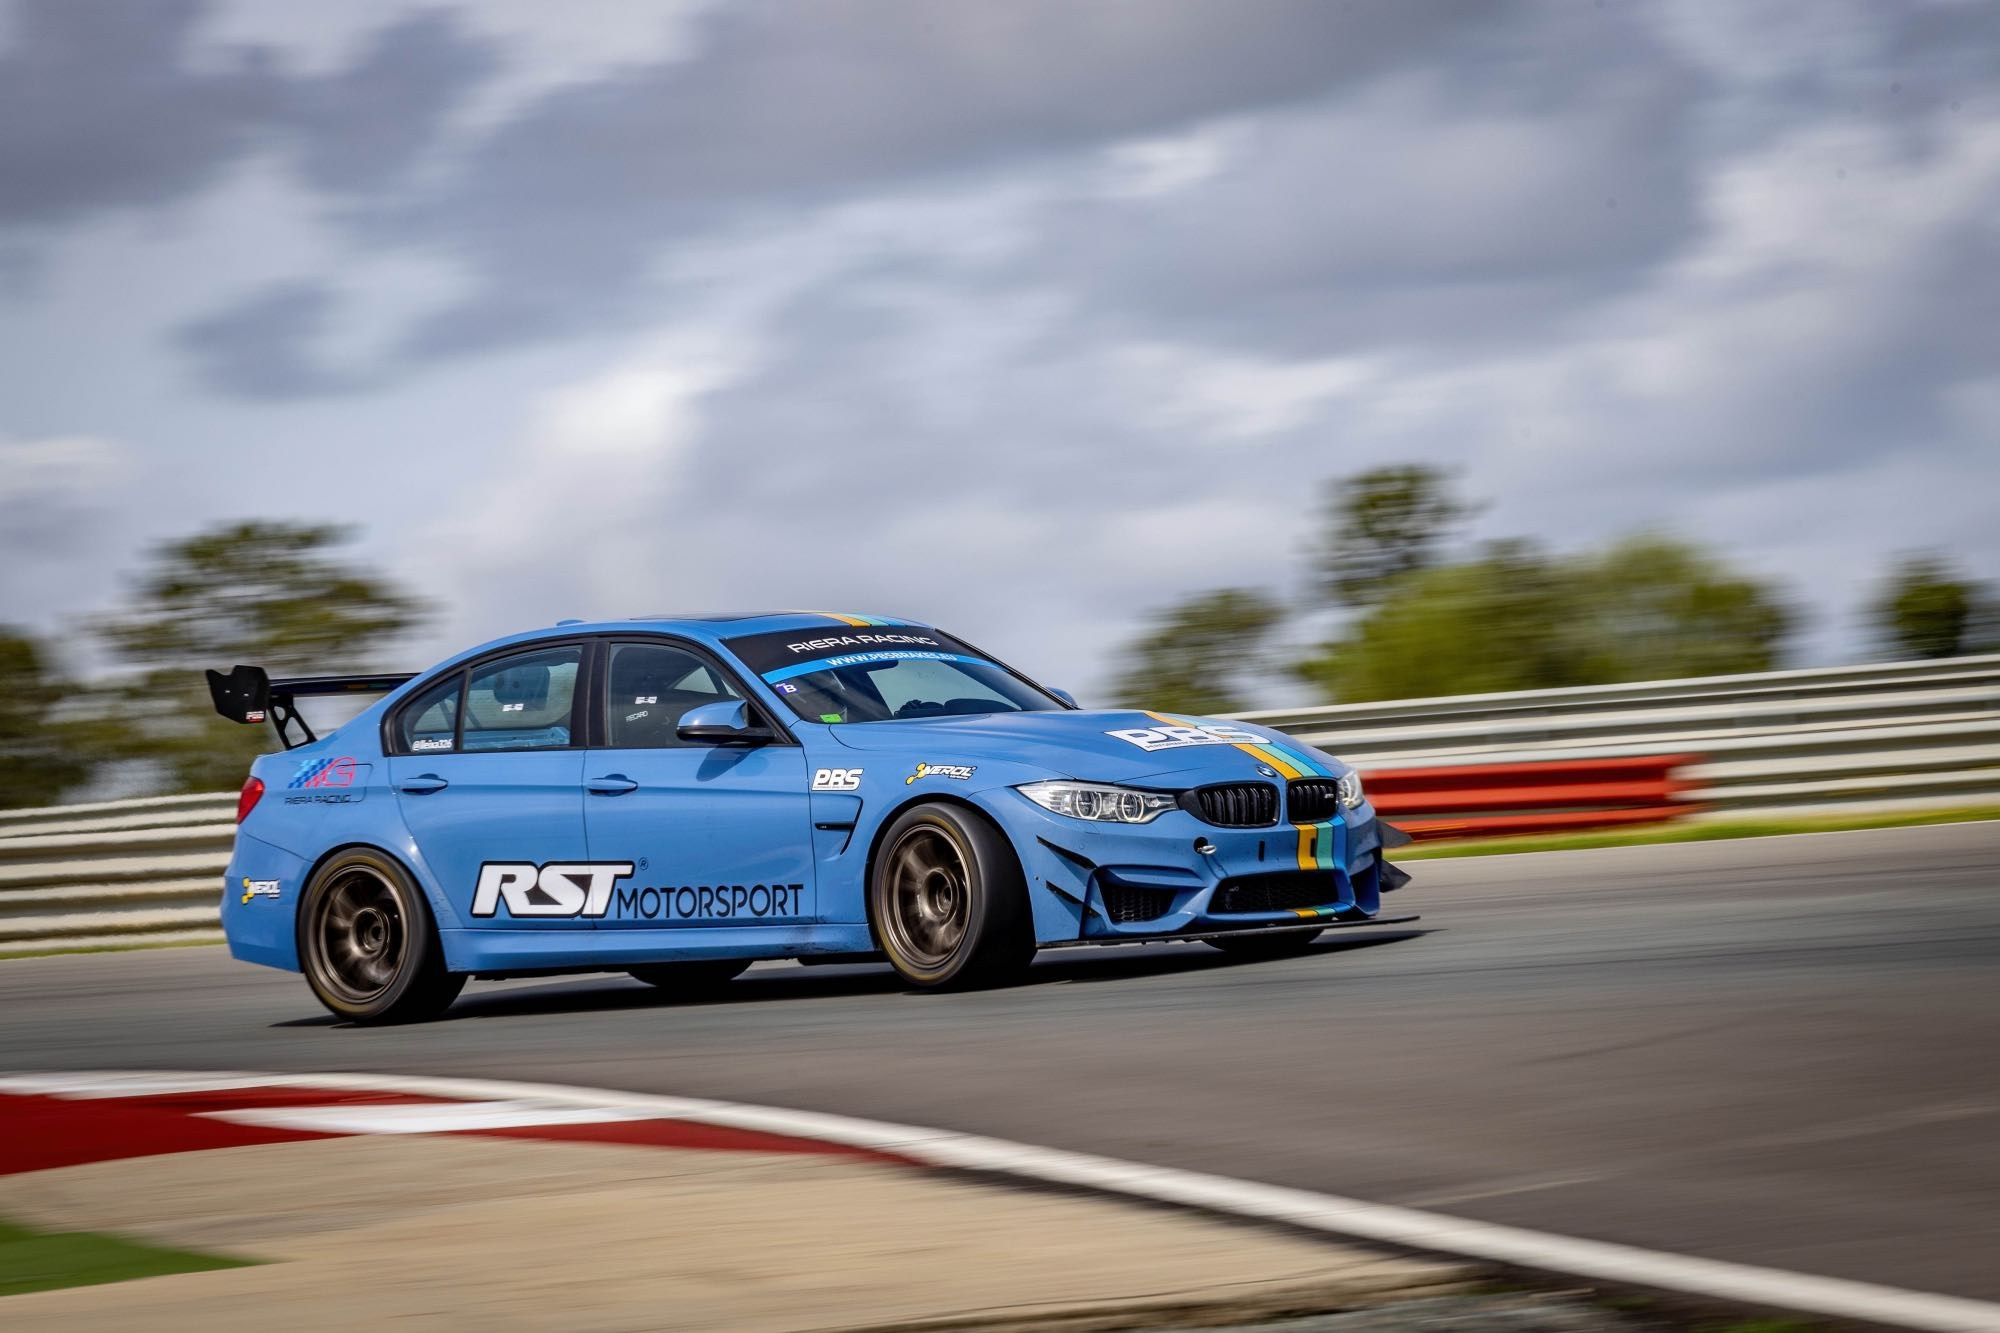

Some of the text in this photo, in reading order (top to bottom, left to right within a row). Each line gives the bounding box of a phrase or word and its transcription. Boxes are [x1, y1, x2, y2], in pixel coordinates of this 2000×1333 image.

[786, 634, 939, 654] RIERA RACING
[783, 684, 797, 694] B
[1104, 726, 1272, 751] PBS
[812, 768, 864, 791] PBS
[471, 861, 635, 918] RST
[617, 884, 804, 919] MOTORSPORT
